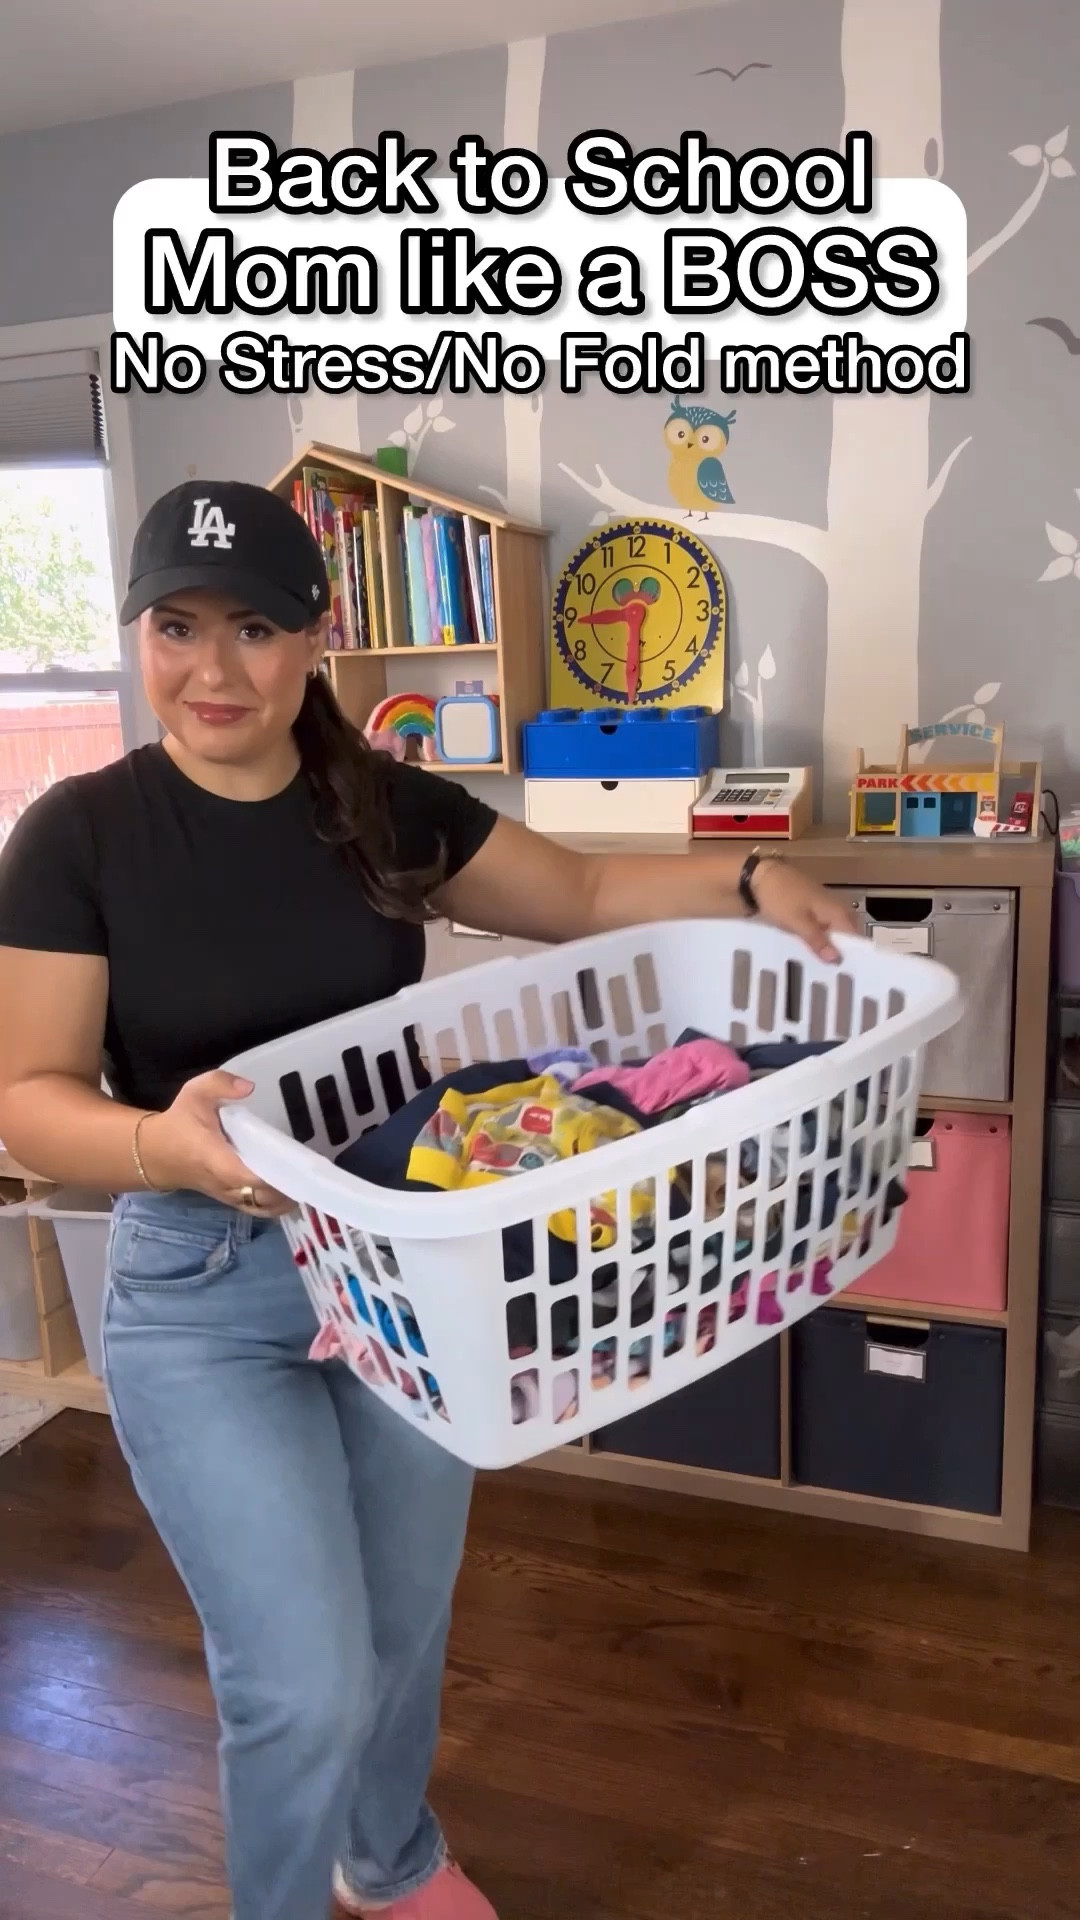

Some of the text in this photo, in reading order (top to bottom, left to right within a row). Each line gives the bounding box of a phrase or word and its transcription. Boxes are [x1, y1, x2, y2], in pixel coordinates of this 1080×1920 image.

[187, 498, 236, 549] LA
[601, 546, 614, 568] 11
[627, 535, 646, 558] 12
[664, 542, 671, 564] 1
[575, 573, 596, 595] 10
[687, 566, 700, 588] 2
[564, 607, 577, 628] 9
[696, 600, 710, 622] 3
[574, 639, 587, 661] 8
[684, 634, 698, 656] 4
[601, 663, 615, 684] 7
[662, 660, 676, 681] 5
[910, 722, 995, 741] SERVICE
[857, 778, 898, 788] PARK
